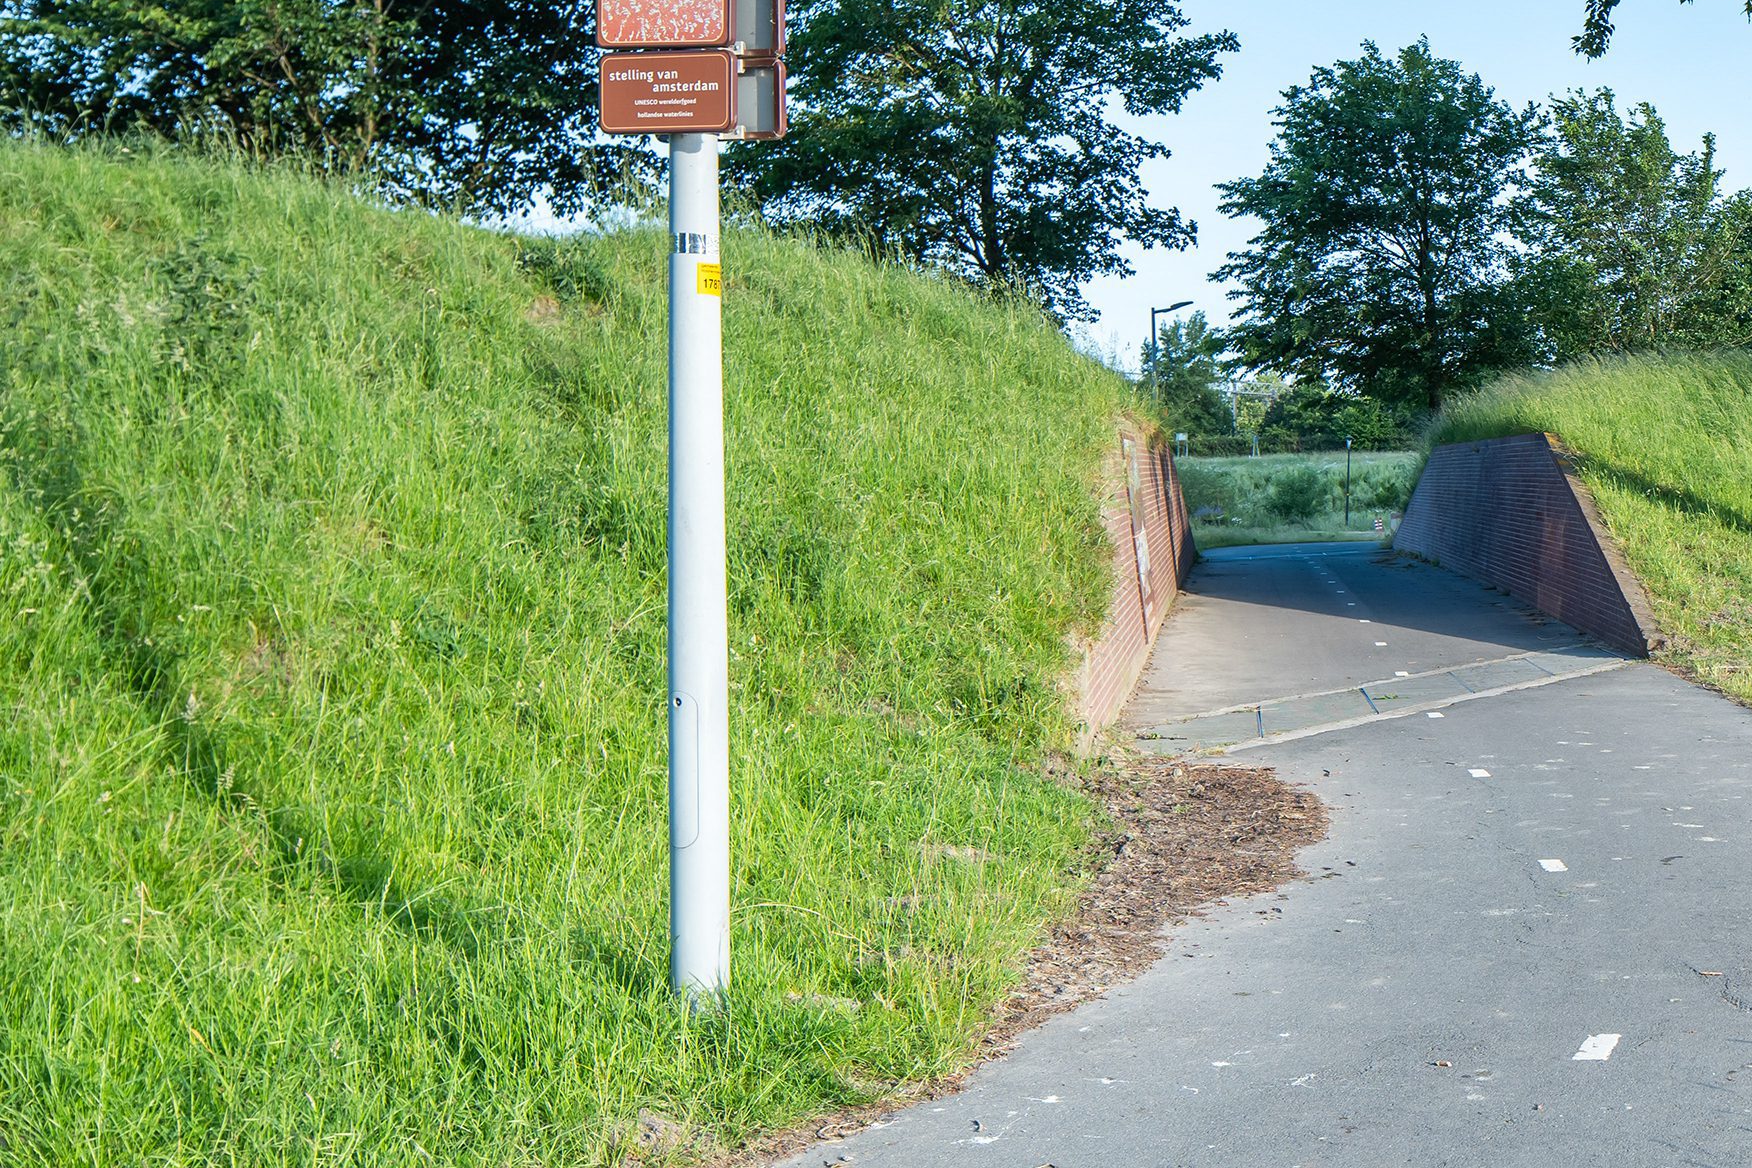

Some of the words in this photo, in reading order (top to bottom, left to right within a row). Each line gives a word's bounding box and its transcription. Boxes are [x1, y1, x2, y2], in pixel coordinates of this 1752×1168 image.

[609, 69, 654, 83] stelling
[657, 70, 678, 79] van
[652, 80, 719, 92] amsterdam
[659, 97, 697, 106] werelderfgoed
